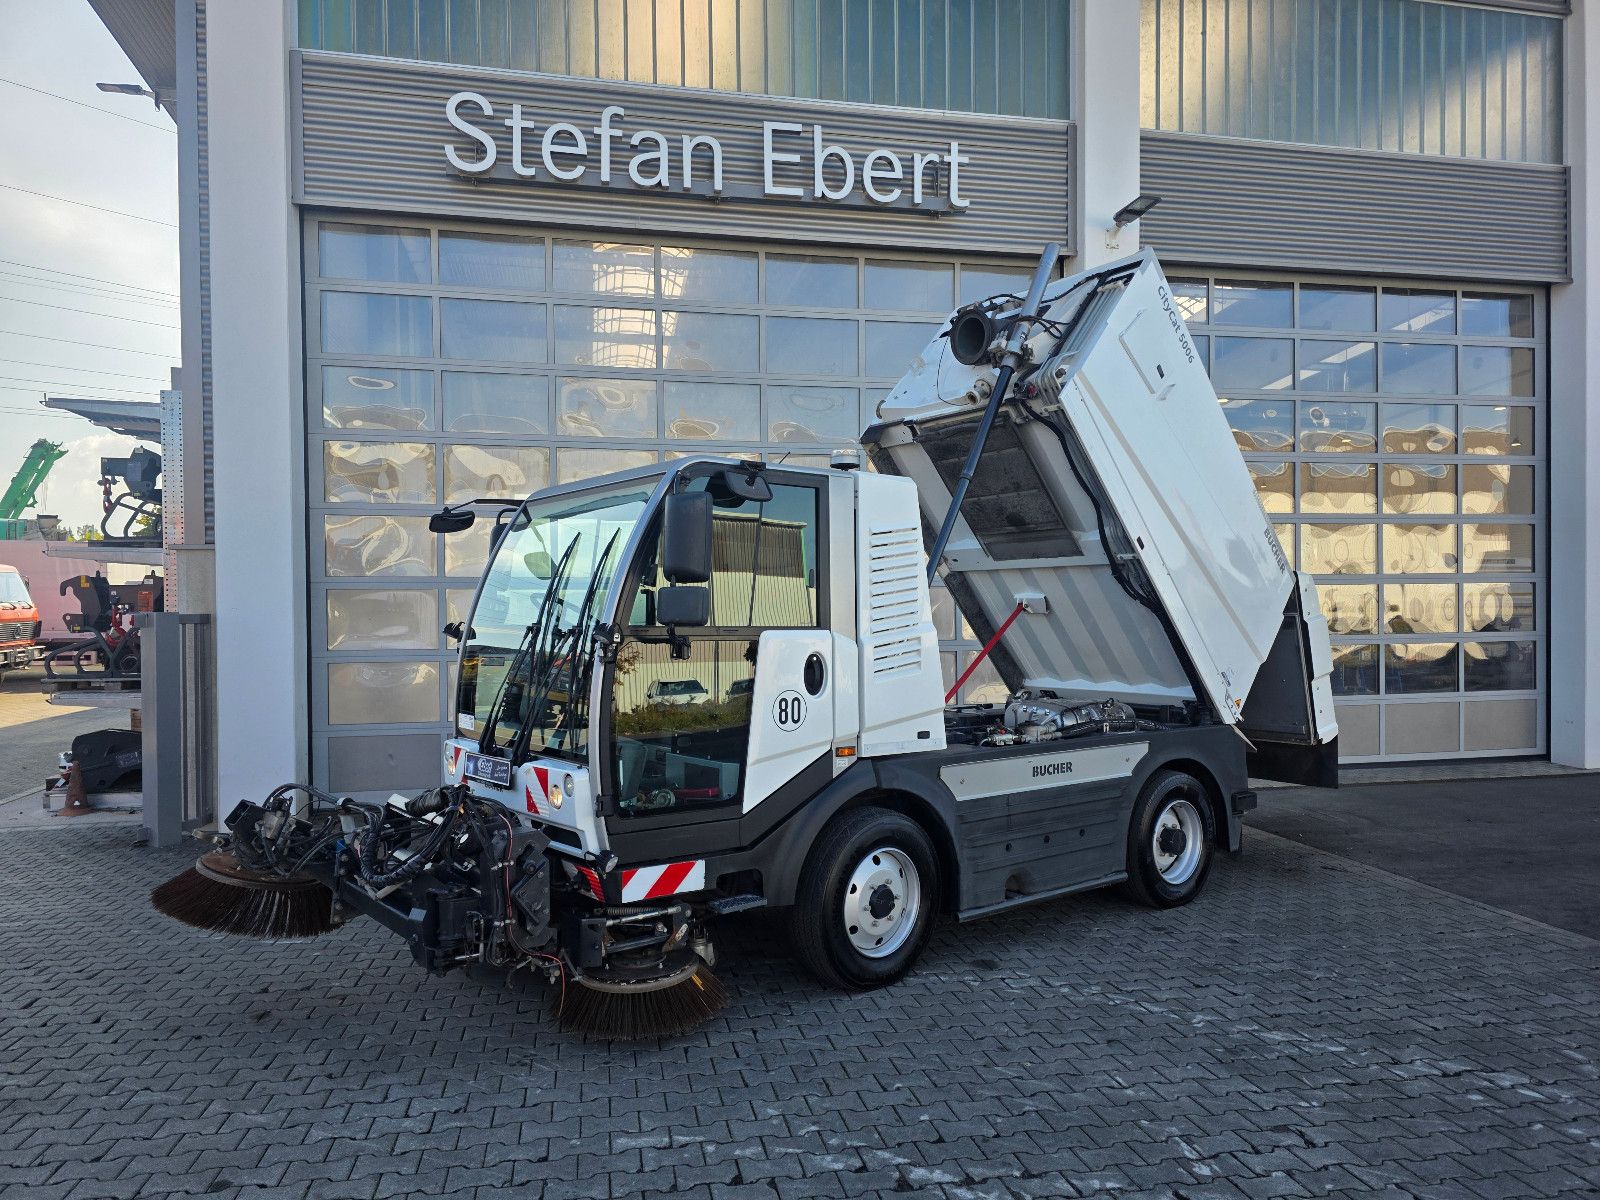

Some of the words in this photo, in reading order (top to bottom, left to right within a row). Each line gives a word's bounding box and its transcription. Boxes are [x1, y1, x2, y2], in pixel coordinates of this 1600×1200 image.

[444, 91, 722, 191] Stefan
[763, 120, 970, 208] Ebert
[1158, 285, 1181, 333] CityCat
[1179, 333, 1195, 364] 5006
[1264, 527, 1286, 575] BUCHER
[778, 697, 801, 725] 80
[1032, 761, 1073, 777] BUCHER
